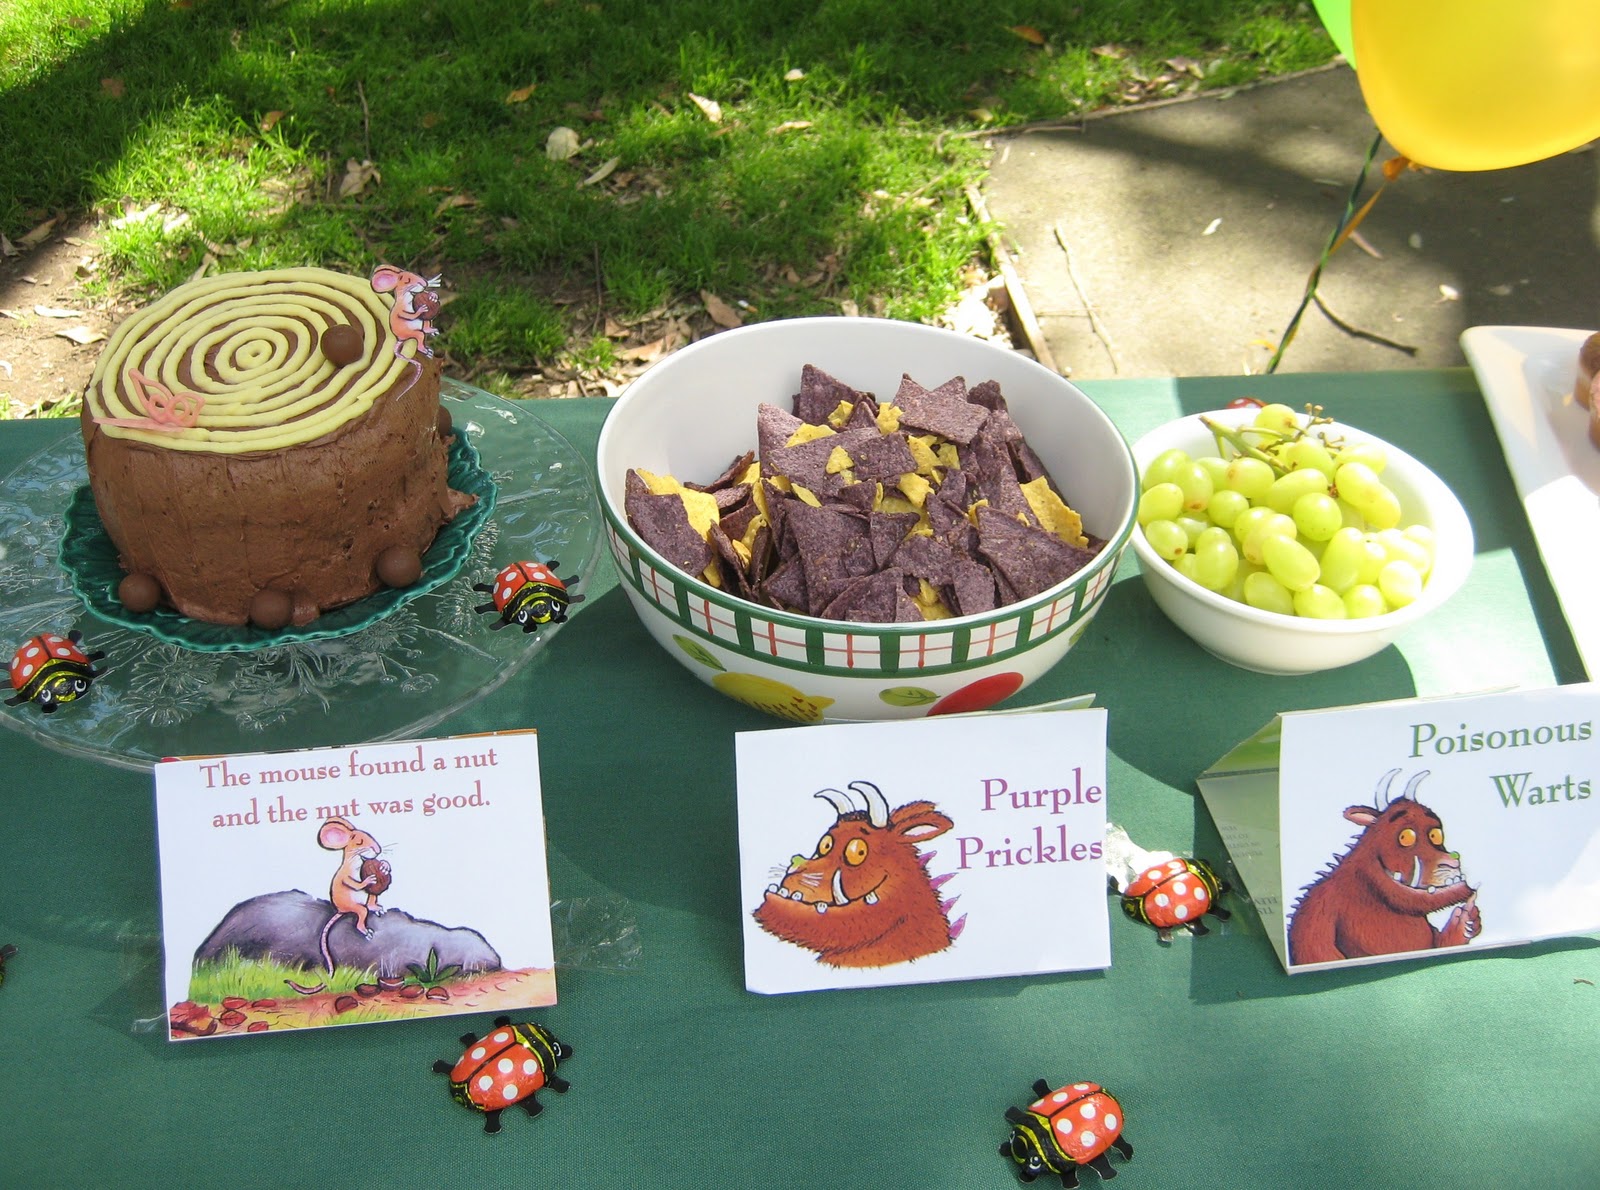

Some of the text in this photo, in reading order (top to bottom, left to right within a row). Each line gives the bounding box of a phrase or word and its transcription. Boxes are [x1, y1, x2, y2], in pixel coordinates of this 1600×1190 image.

[1408, 720, 1592, 758] Poisonous
[200, 744, 498, 788] The mouse found a nut
[212, 779, 491, 828] and the nut was good.
[980, 767, 1102, 815] Purple
[1489, 772, 1592, 809] Warts
[956, 824, 1103, 870] Prickles
